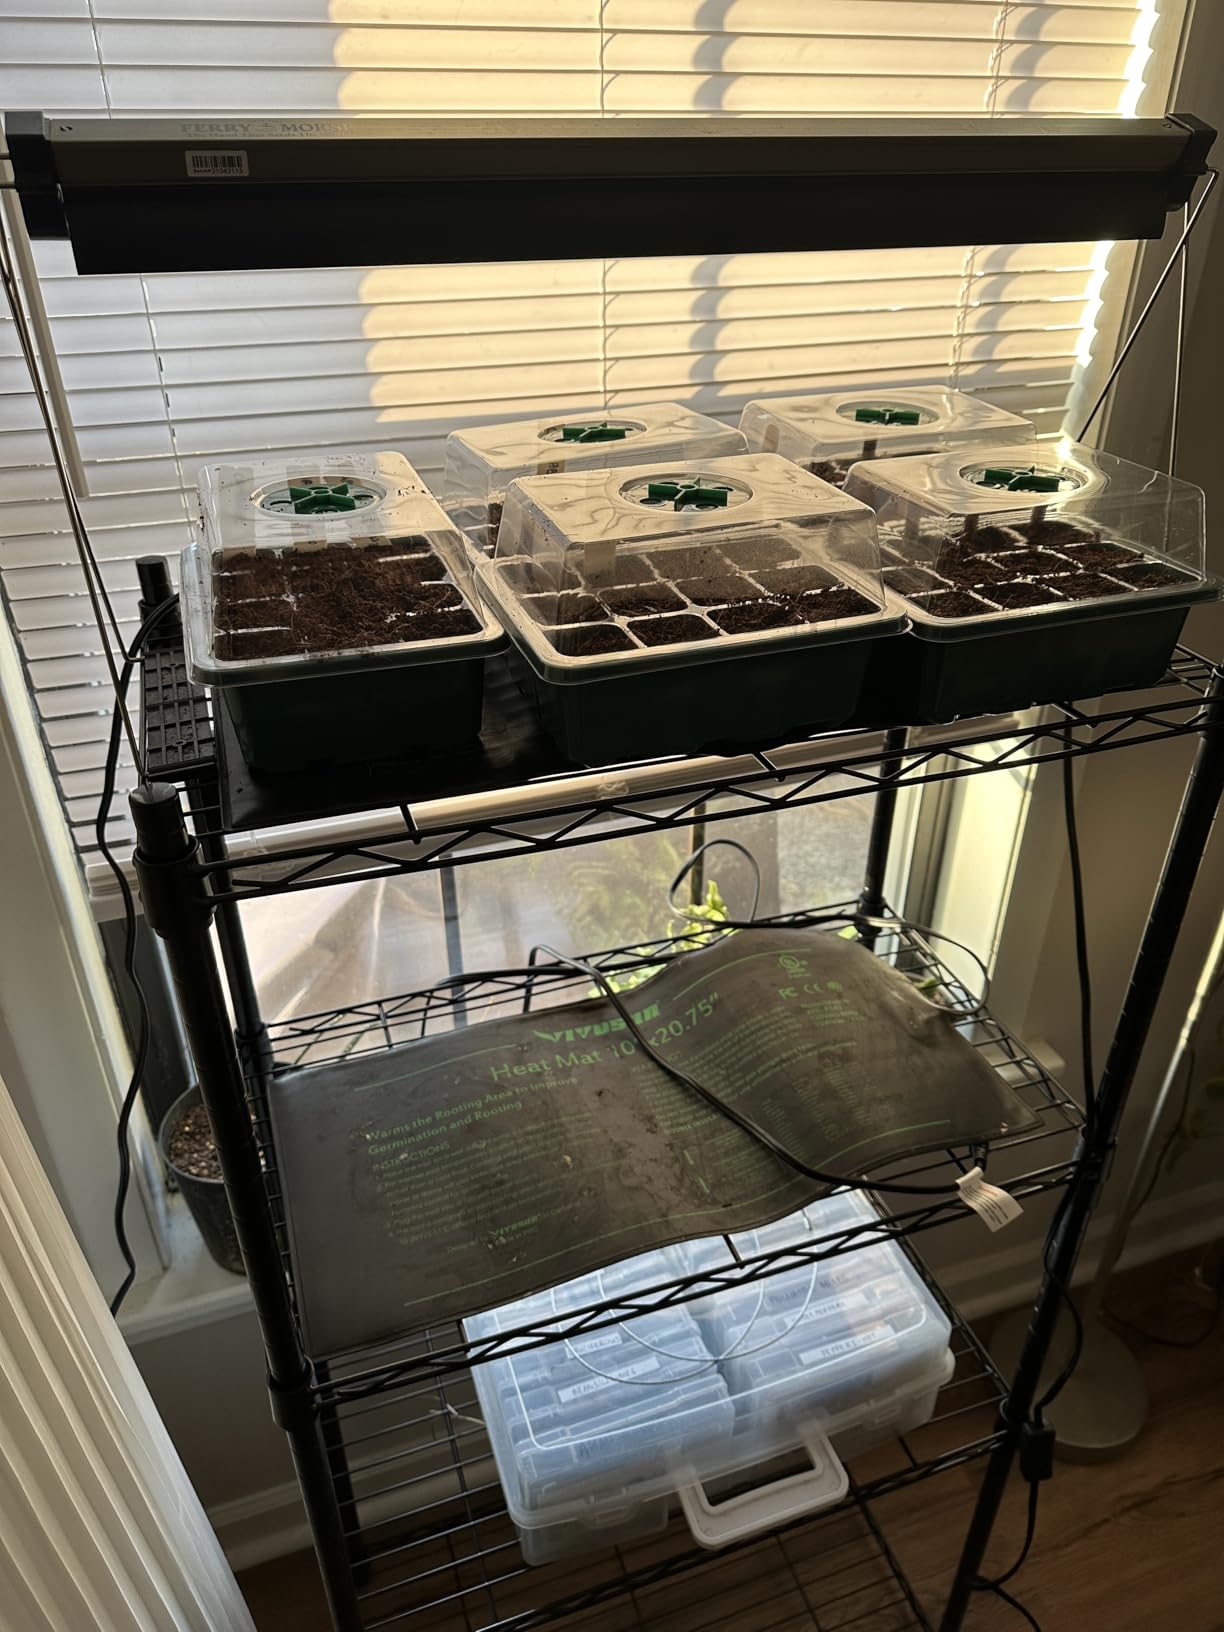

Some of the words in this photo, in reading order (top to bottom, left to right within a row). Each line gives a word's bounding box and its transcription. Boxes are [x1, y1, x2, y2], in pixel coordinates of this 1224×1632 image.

[180, 122, 251, 133] FERRY
[490, 1060, 551, 1081] Heat
[554, 1049, 602, 1069] Mat
[366, 1124, 410, 1142] Warms
[411, 1115, 433, 1132] the
[434, 1098, 484, 1121] Rooting
[484, 1090, 513, 1104] Area
[530, 1075, 579, 1096] Improve
[367, 1124, 448, 1155] Germination
[449, 1111, 473, 1129] and
[474, 1100, 523, 1121] Rooting
